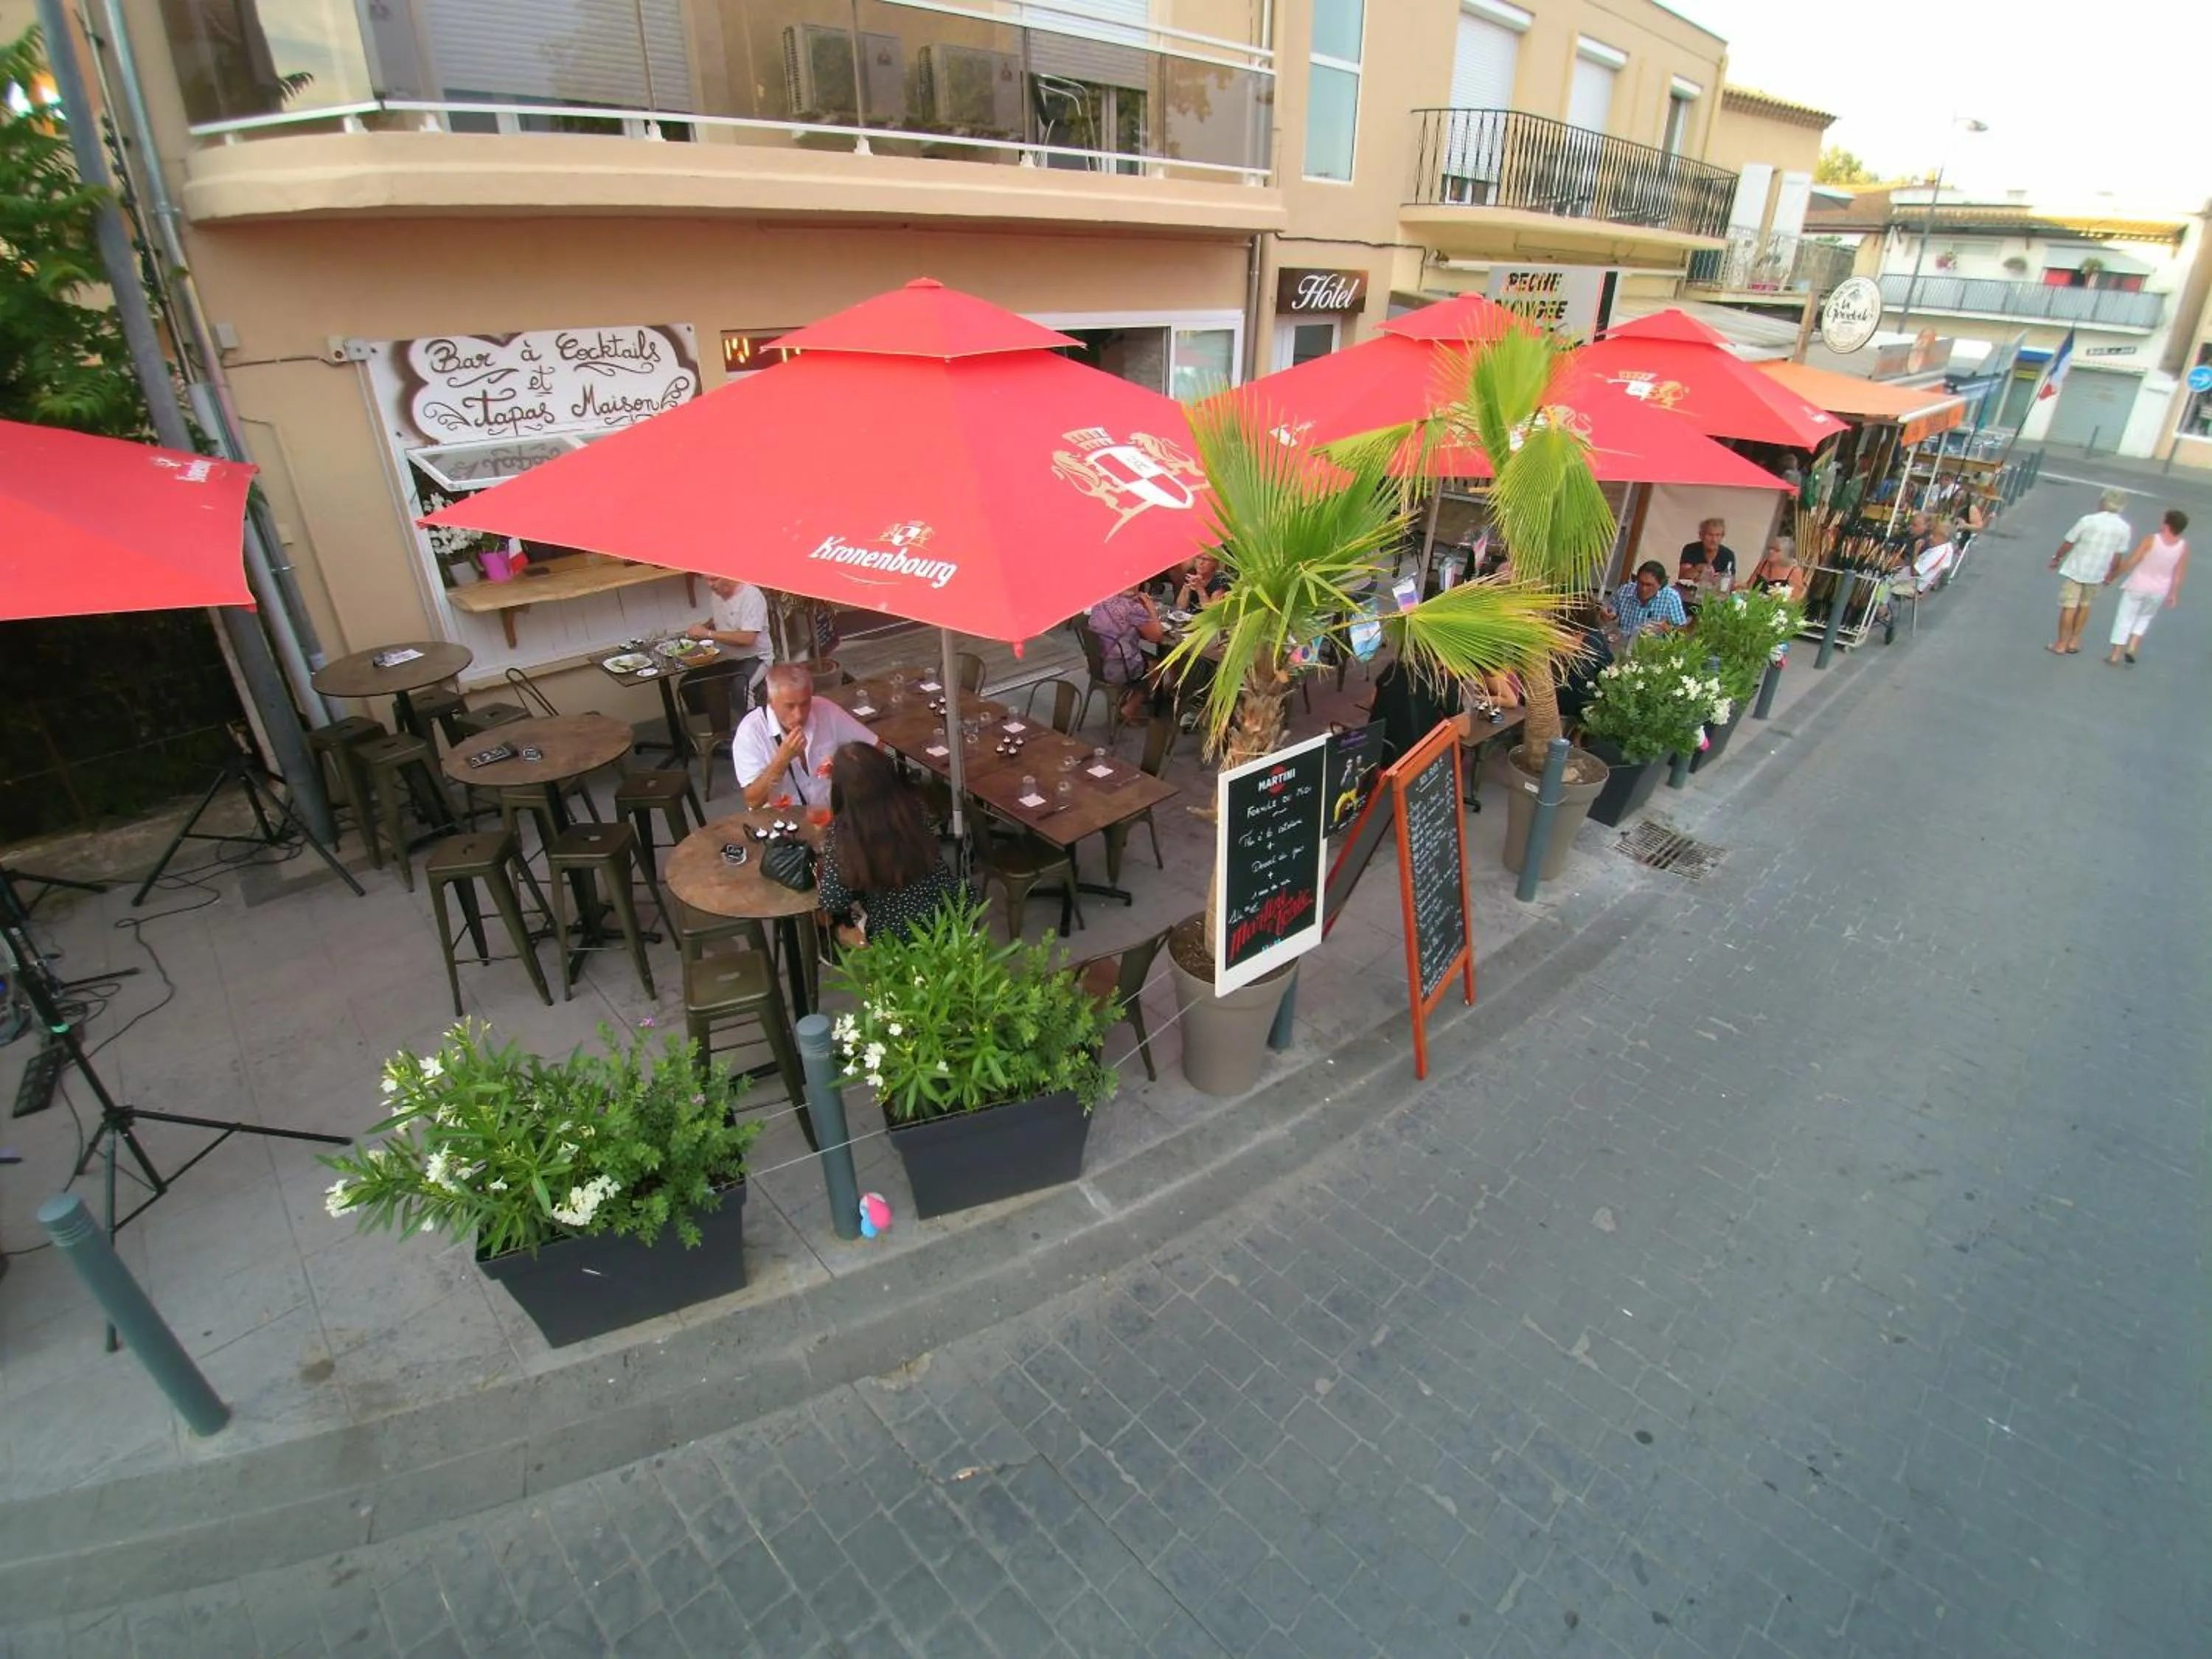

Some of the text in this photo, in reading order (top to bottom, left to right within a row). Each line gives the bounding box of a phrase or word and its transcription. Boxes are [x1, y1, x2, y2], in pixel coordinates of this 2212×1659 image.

[1292, 274, 1360, 310] Hôtel
[425, 331, 661, 373] Bar à Cocktails
[528, 365, 555, 392] et
[462, 383, 664, 437] Tapas Maison
[808, 535, 959, 590] Kronenbourg
[1258, 768, 1296, 793] MARTINI
